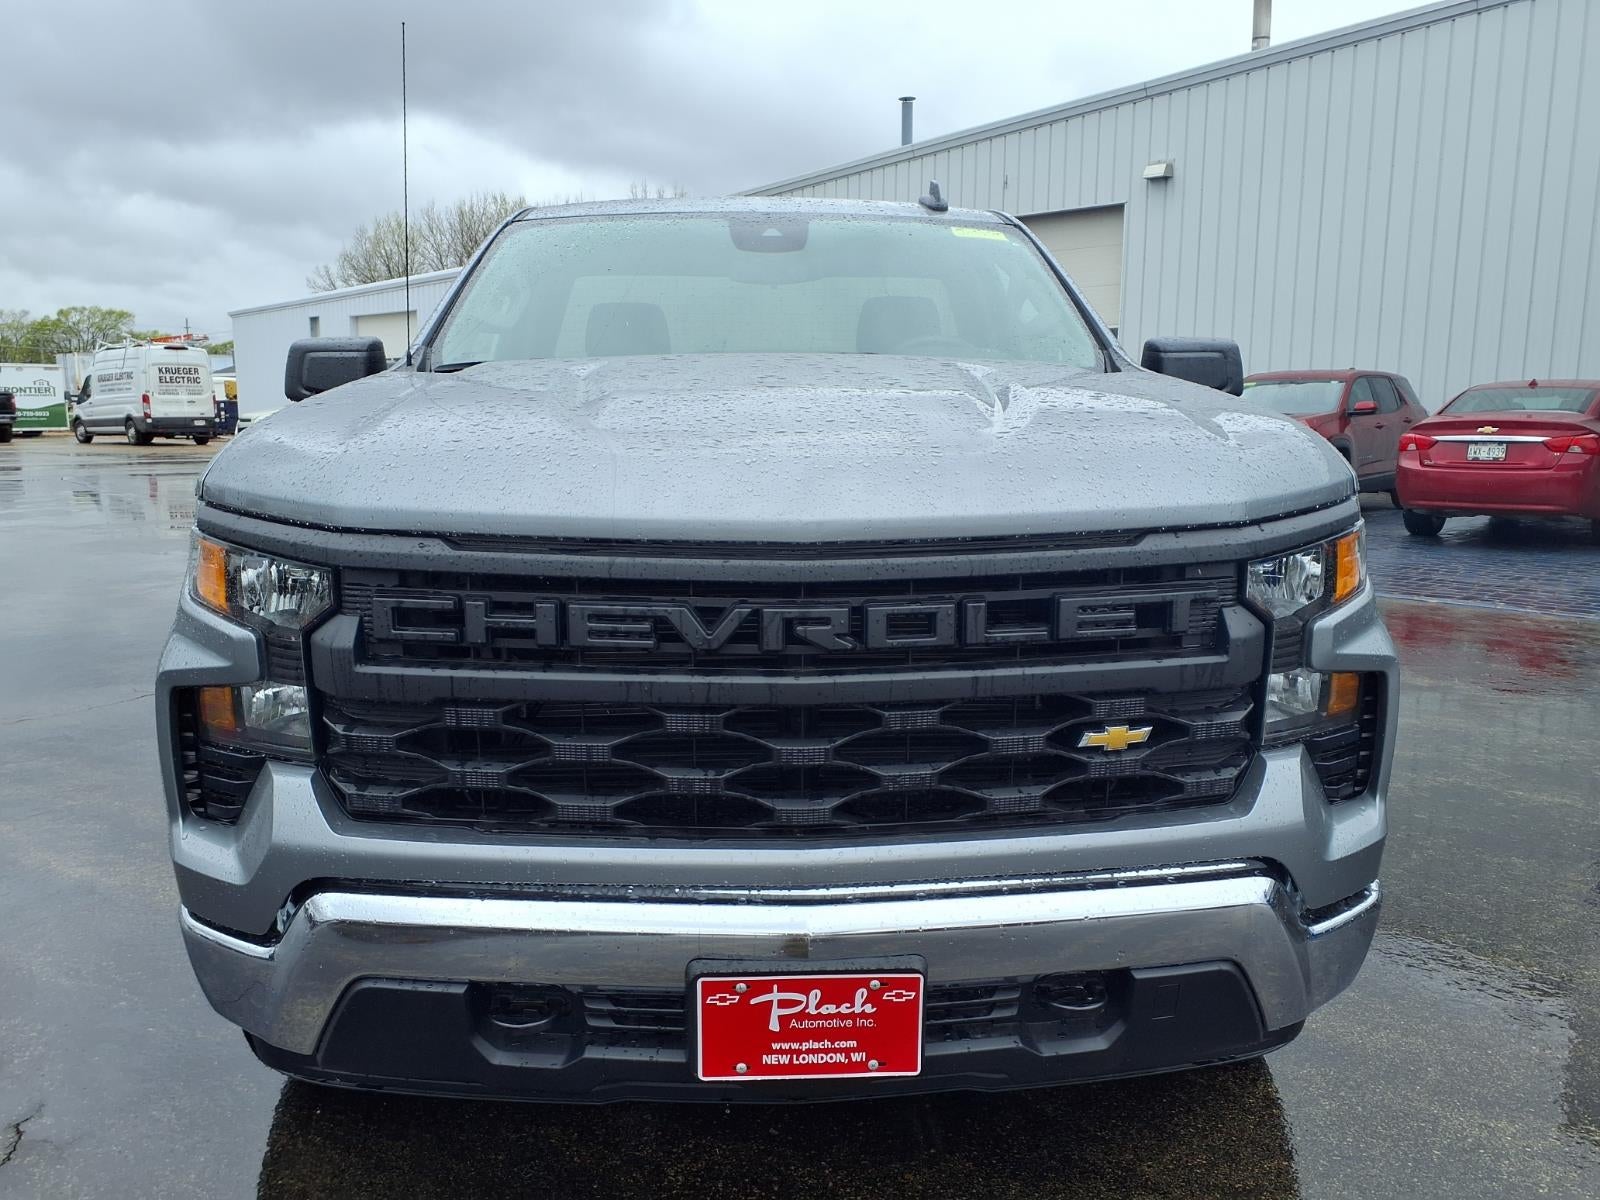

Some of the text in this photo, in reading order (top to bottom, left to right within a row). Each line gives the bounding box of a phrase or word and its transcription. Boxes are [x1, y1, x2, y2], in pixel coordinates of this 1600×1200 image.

[158, 366, 200, 375] KRUEGER
[159, 375, 201, 384] ELECTRIC
[371, 588, 1218, 652] CHEVROLET
[750, 984, 877, 1032] Plach
[789, 1017, 877, 1029] Automotive Inc.
[771, 1039, 857, 1051] www.plach.com
[762, 1052, 866, 1065] NEW LONDON, WI
